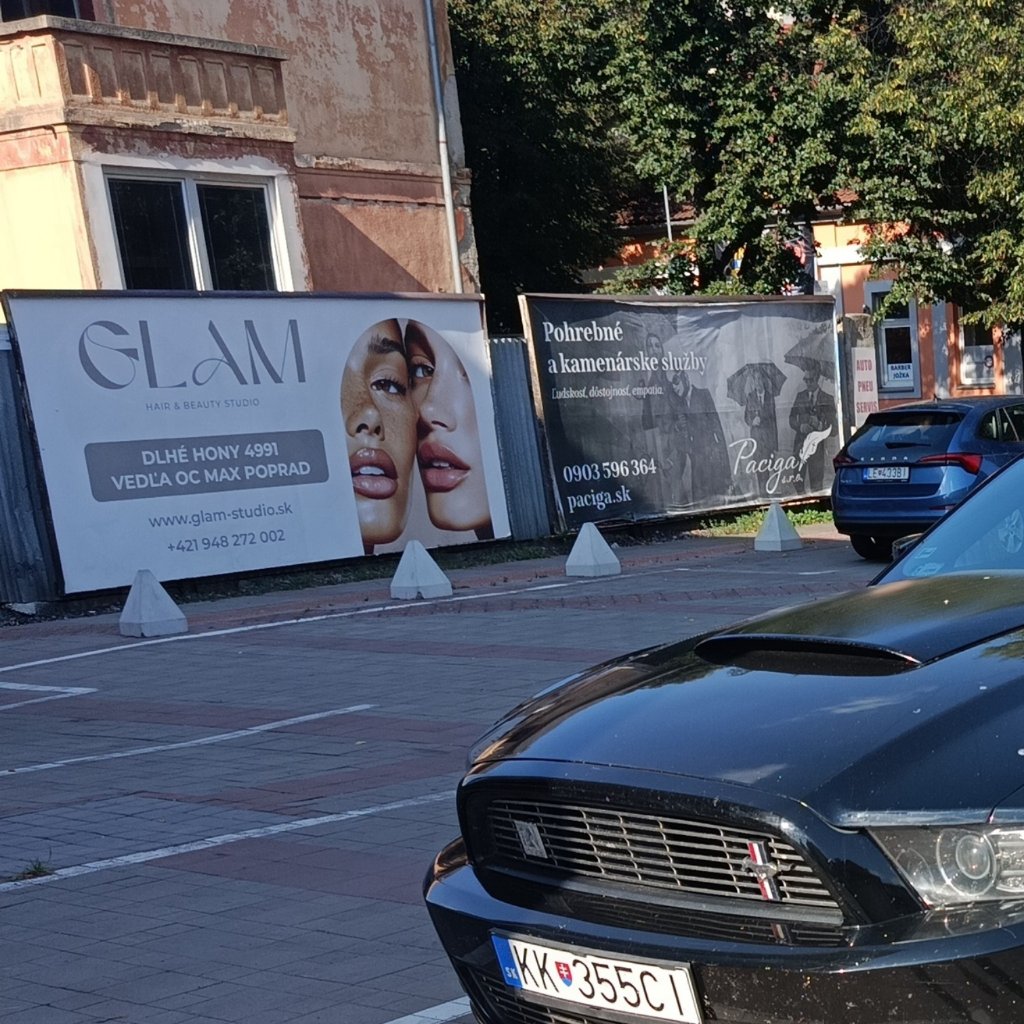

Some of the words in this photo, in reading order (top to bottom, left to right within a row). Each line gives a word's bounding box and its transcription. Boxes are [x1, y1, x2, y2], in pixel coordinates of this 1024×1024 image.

[542, 320, 624, 343] Pohrebné
[78, 319, 306, 390] GLAM
[547, 358, 558, 374] a
[558, 351, 659, 374] kamenárske
[661, 351, 708, 376] služby
[856, 359, 873, 371] AUTO
[857, 380, 874, 392] PNEU
[145, 402, 172, 411] HAIR
[173, 401, 181, 411] &
[183, 400, 221, 410] BEAUTY
[223, 398, 260, 409] STUDIO
[856, 401, 878, 413] SERVIS
[141, 445, 189, 466] DLHÉ
[192, 445, 241, 463] HONY
[244, 442, 279, 458] 4991
[728, 437, 800, 494] Paciga
[111, 472, 172, 491] VEDĽA
[175, 469, 201, 486] OC
[204, 466, 241, 484] MAX
[244, 461, 311, 480] POPRAD
[563, 463, 600, 483] 0903
[602, 460, 630, 479] 596
[630, 457, 657, 476] 364
[567, 485, 632, 513] paciga.sk
[149, 502, 293, 528] www.glam-studio.sk
[167, 538, 199, 553] +421
[202, 535, 230, 551] 948
[232, 532, 257, 547] 272
[259, 529, 286, 544] 002
[505, 966, 518, 980] SK
